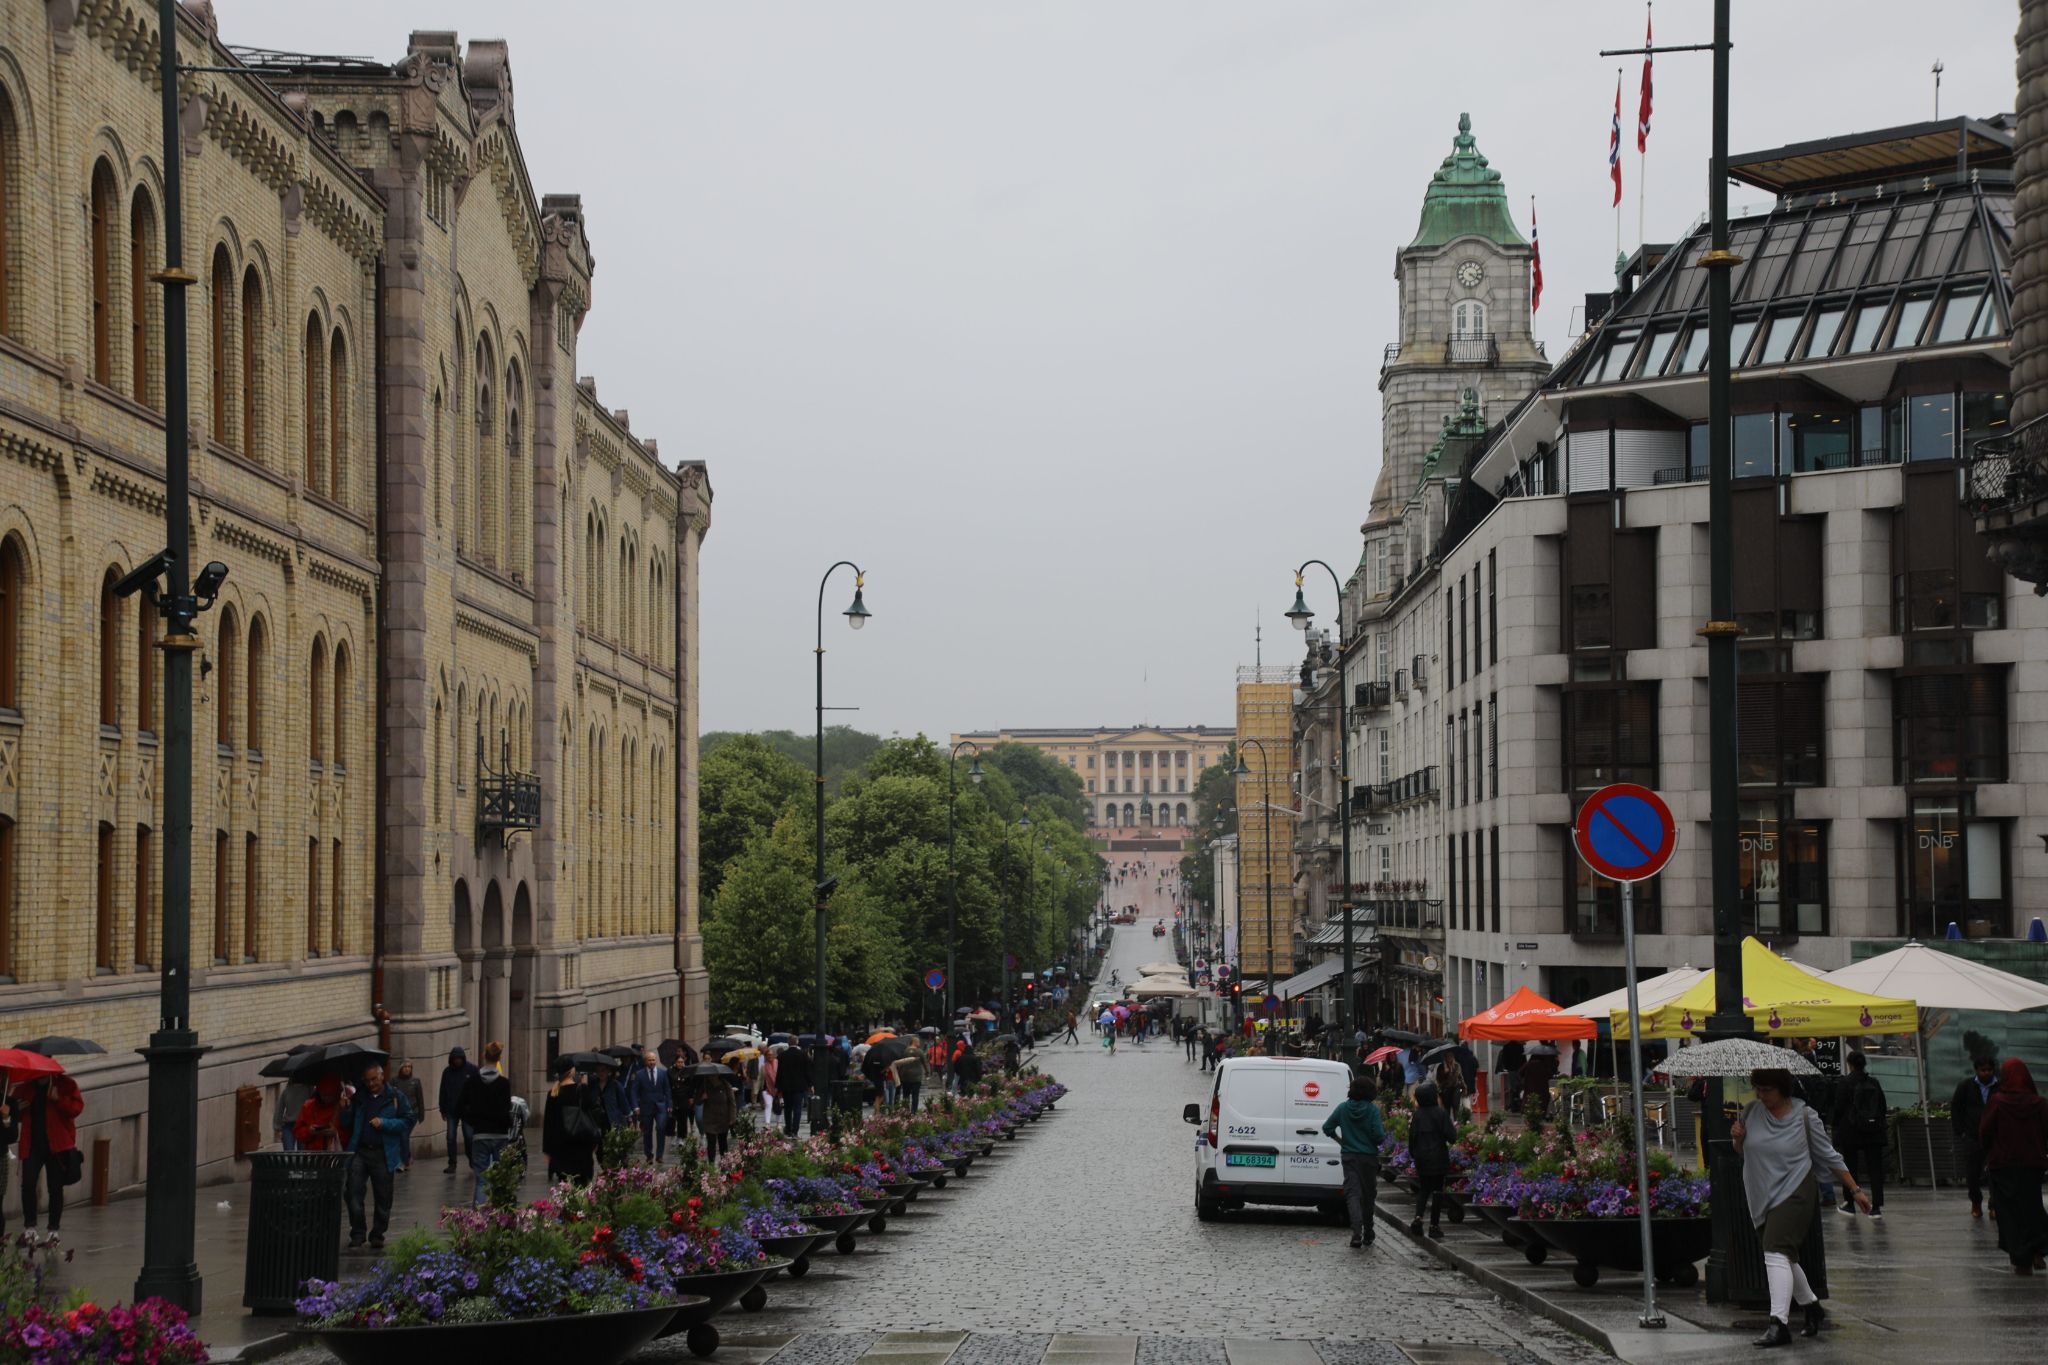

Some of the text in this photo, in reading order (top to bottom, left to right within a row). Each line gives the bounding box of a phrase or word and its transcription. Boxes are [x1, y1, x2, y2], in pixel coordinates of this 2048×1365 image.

[1742, 838, 1774, 852] DNB
[1919, 835, 1954, 849] DNB
[1874, 1013, 1903, 1021] norges
[1816, 1040, 1836, 1050] 9-17
[1817, 1061, 1841, 1071] 10-15
[1228, 1125, 1256, 1134] 2-622
[1245, 1155, 1272, 1165] 68394
[1290, 1156, 1320, 1164] NOKAS
